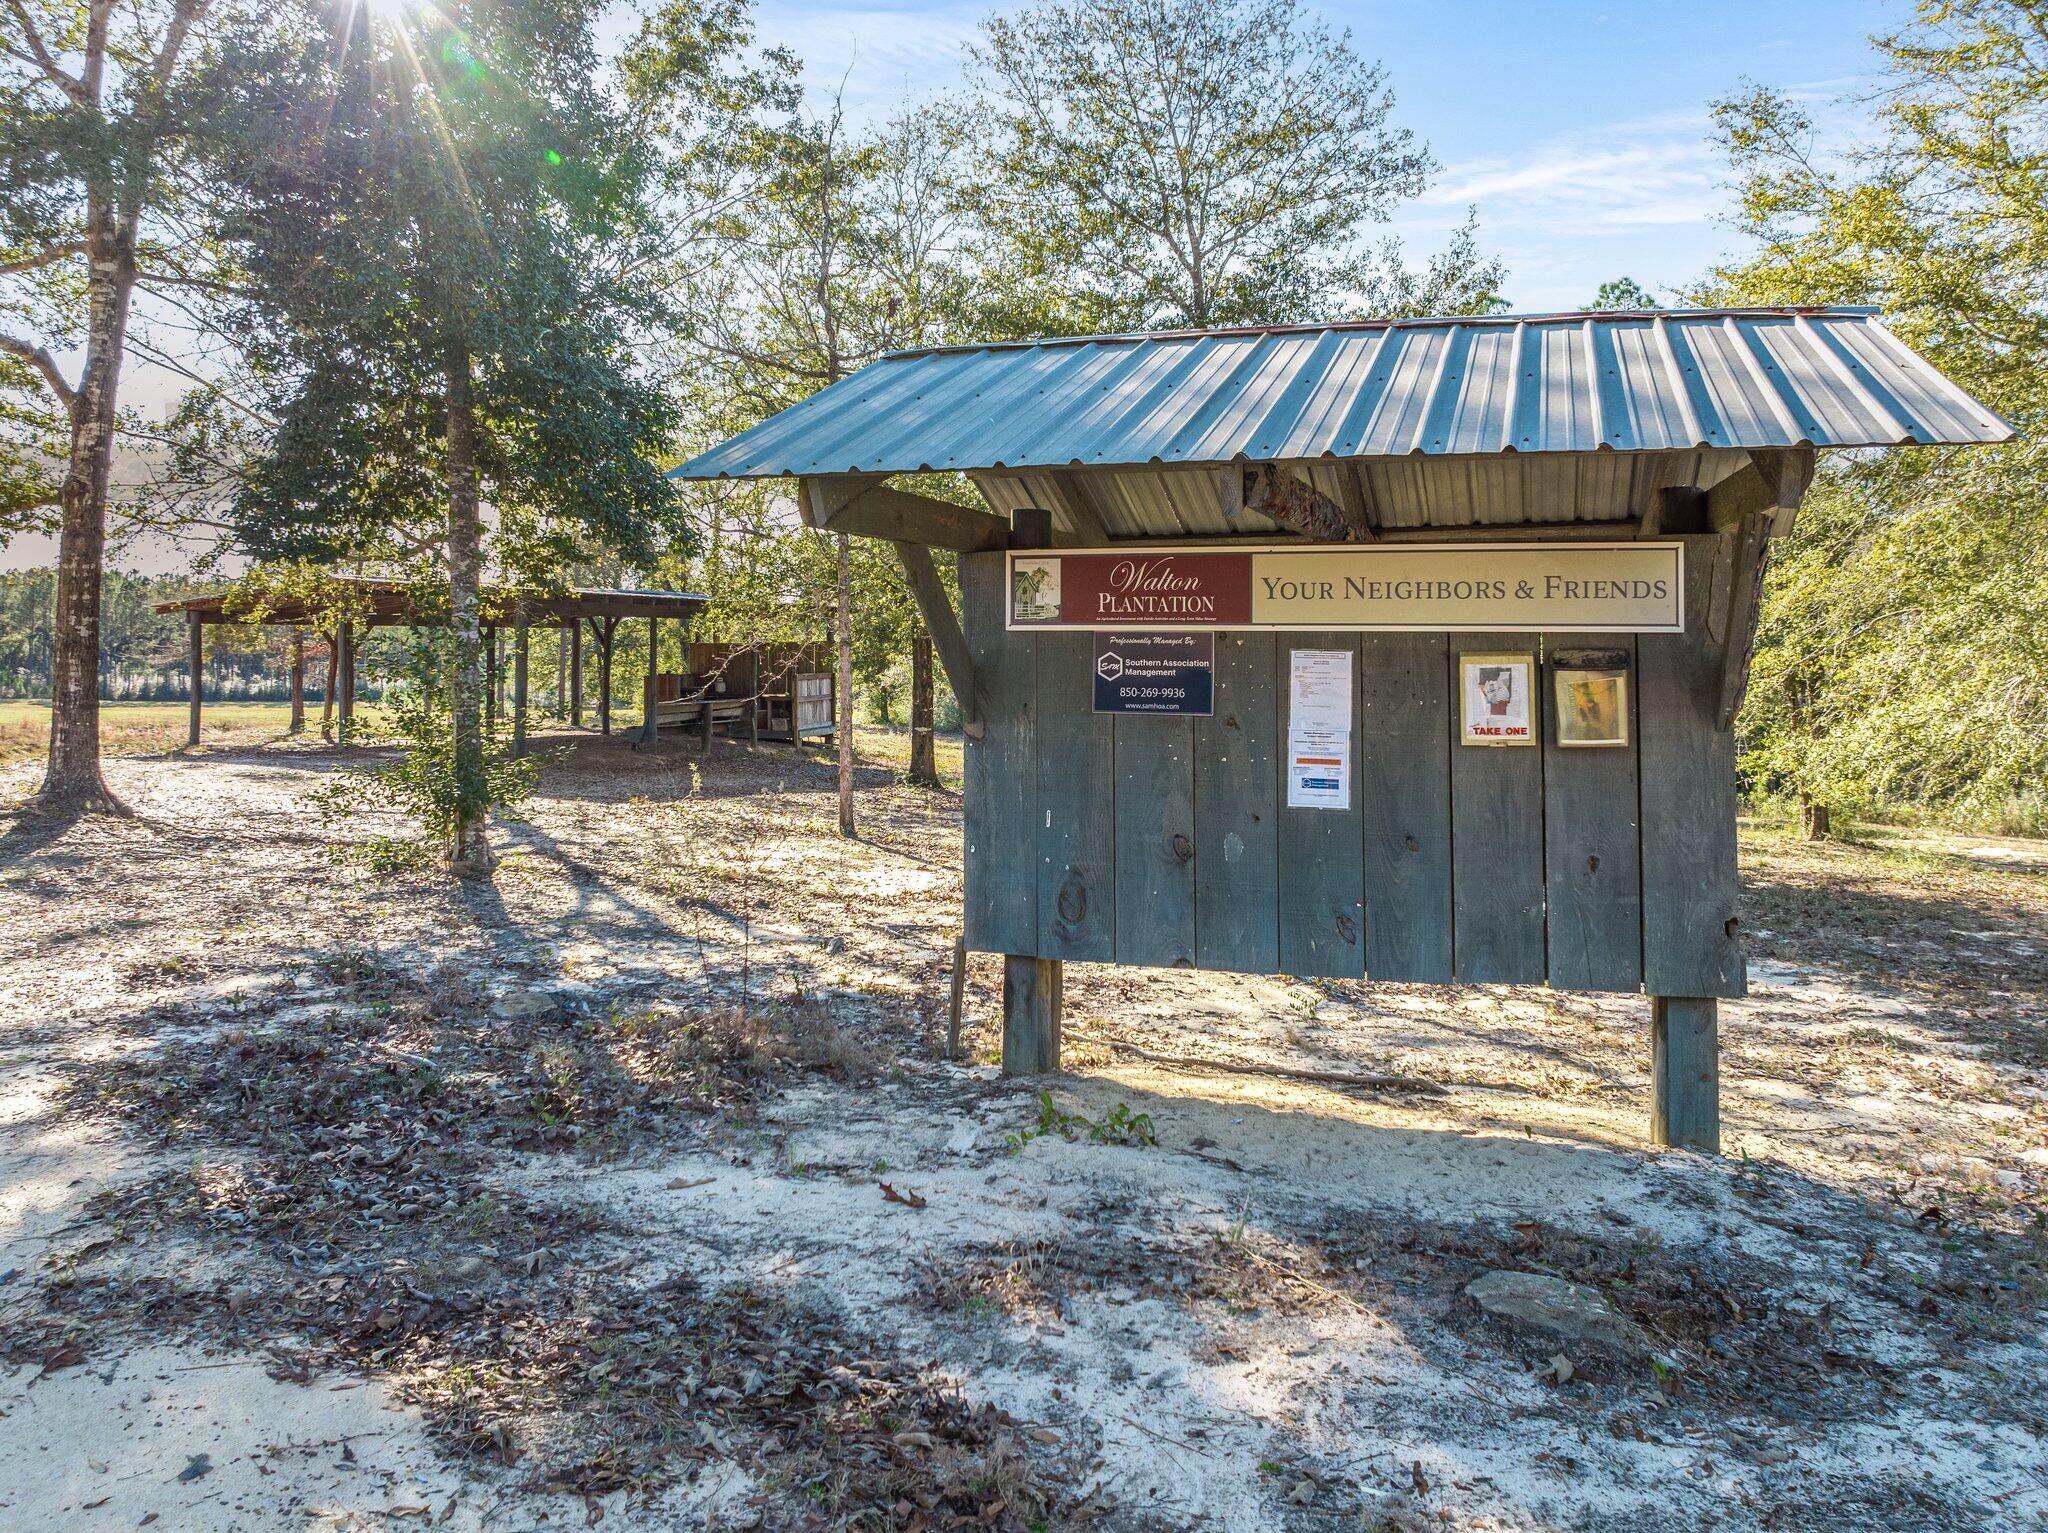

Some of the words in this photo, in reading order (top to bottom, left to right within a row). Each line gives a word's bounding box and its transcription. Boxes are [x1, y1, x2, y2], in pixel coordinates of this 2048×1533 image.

[1110, 556, 1202, 593] Walton
[1260, 576, 1334, 600] YOUR
[1343, 576, 1506, 600] NEIGHBORS
[1514, 579, 1534, 600] &
[1544, 575, 1667, 600] FRIENDS
[1098, 592, 1215, 613] PLANTATION
[1109, 636, 1151, 646] Professionally
[1152, 636, 1183, 647] Managed
[1184, 636, 1197, 647] By:
[1125, 659, 1161, 667] Southern
[1162, 659, 1210, 667] Association
[1125, 668, 1176, 678] Management
[1119, 687, 1185, 698] 850-269-9936
[1473, 727, 1501, 736] TAKE
[1505, 727, 1528, 735] ONE
